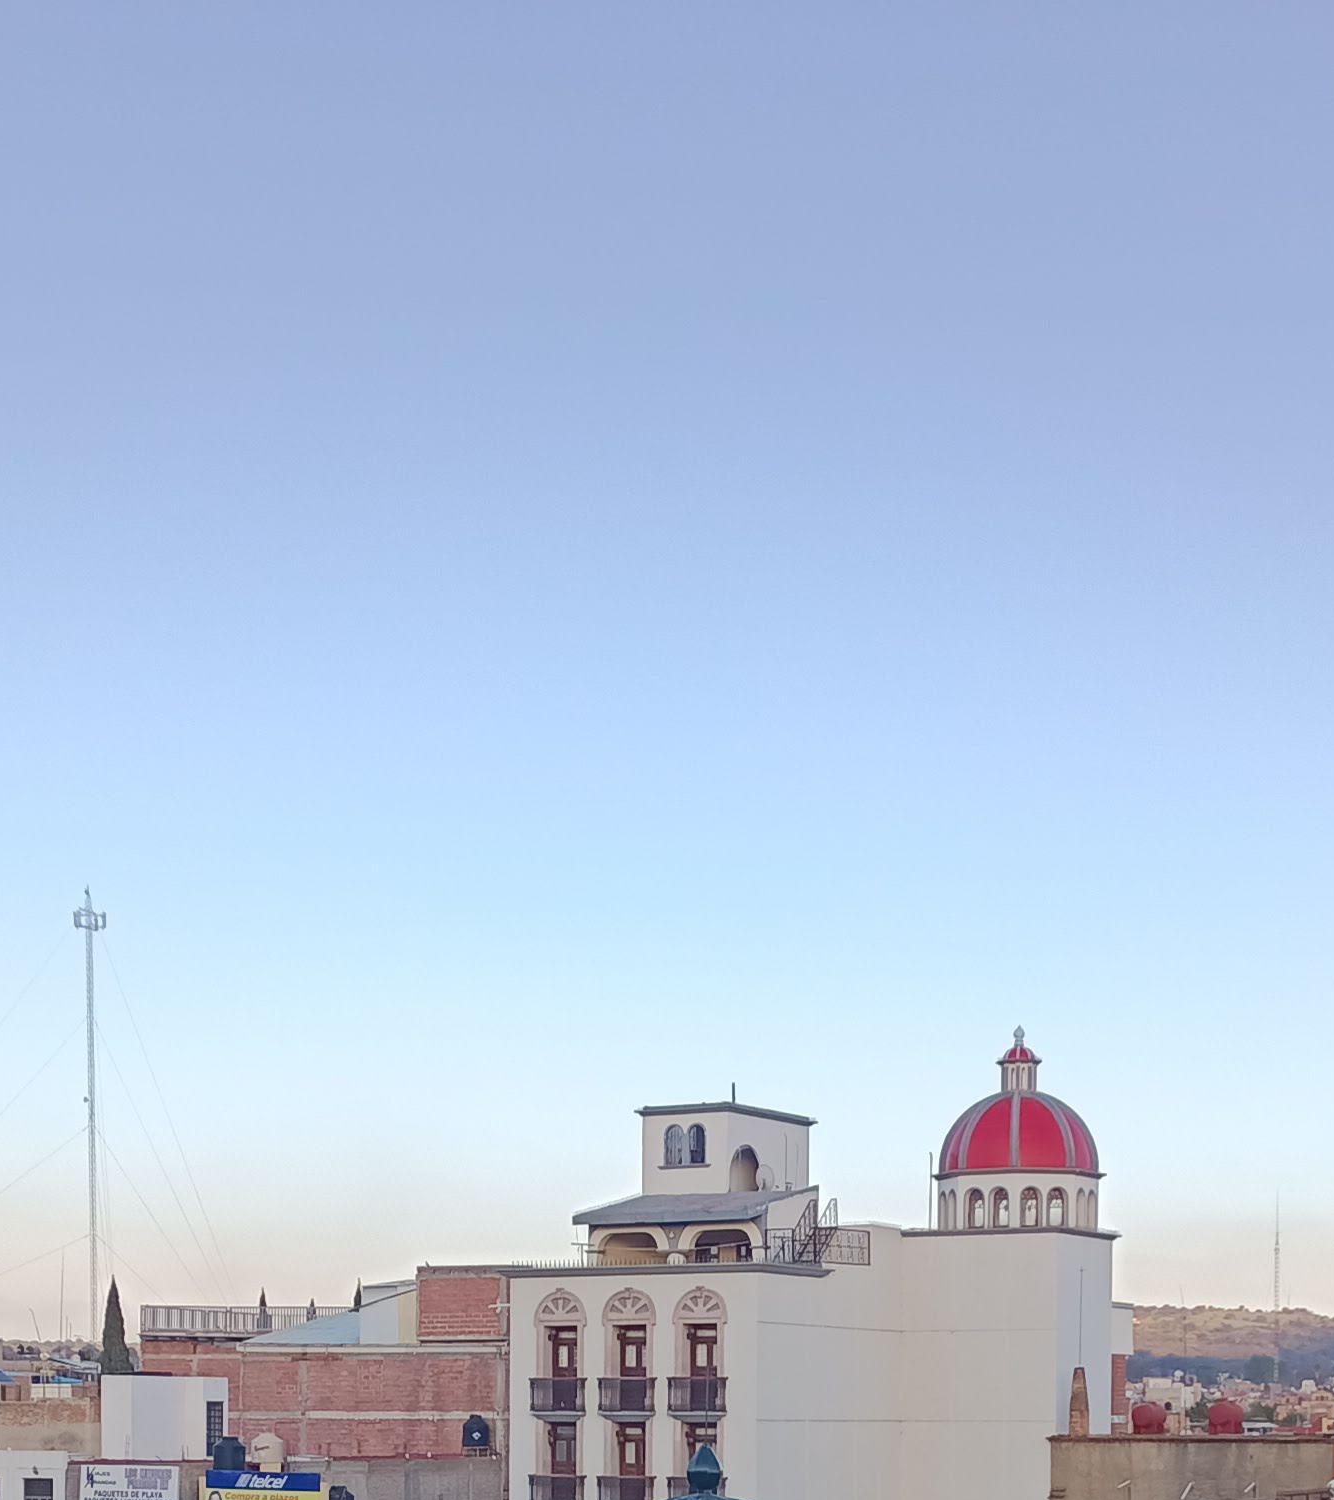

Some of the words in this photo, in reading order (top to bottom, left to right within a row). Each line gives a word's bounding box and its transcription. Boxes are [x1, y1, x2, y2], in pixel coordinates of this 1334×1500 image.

[249, 1473, 288, 1489] telcel
[93, 1490, 128, 1498] PAQUETES
[141, 1491, 163, 1499] PLAYA
